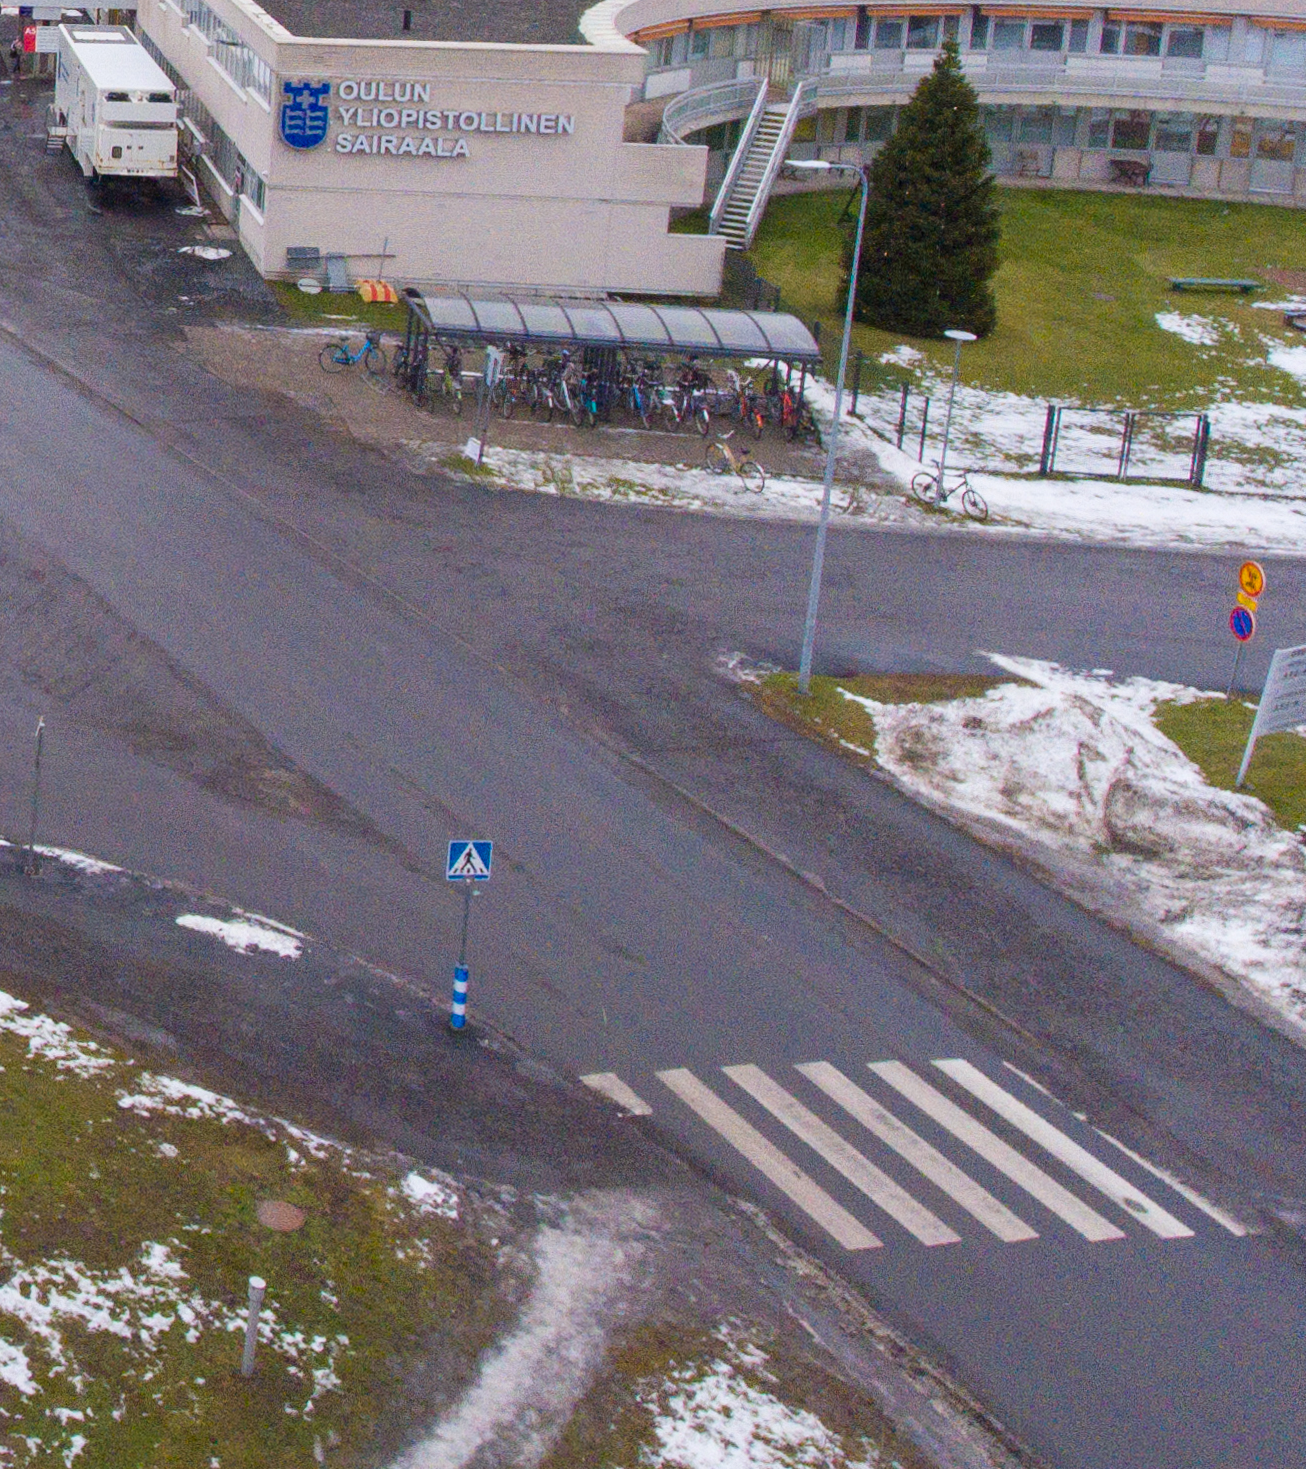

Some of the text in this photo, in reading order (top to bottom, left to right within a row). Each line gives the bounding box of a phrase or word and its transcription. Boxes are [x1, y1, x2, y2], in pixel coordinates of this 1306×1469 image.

[339, 81, 430, 103] OULUN
[338, 107, 575, 134] YLIOPISTOLLINEN
[336, 134, 470, 157] SAIRAALA
